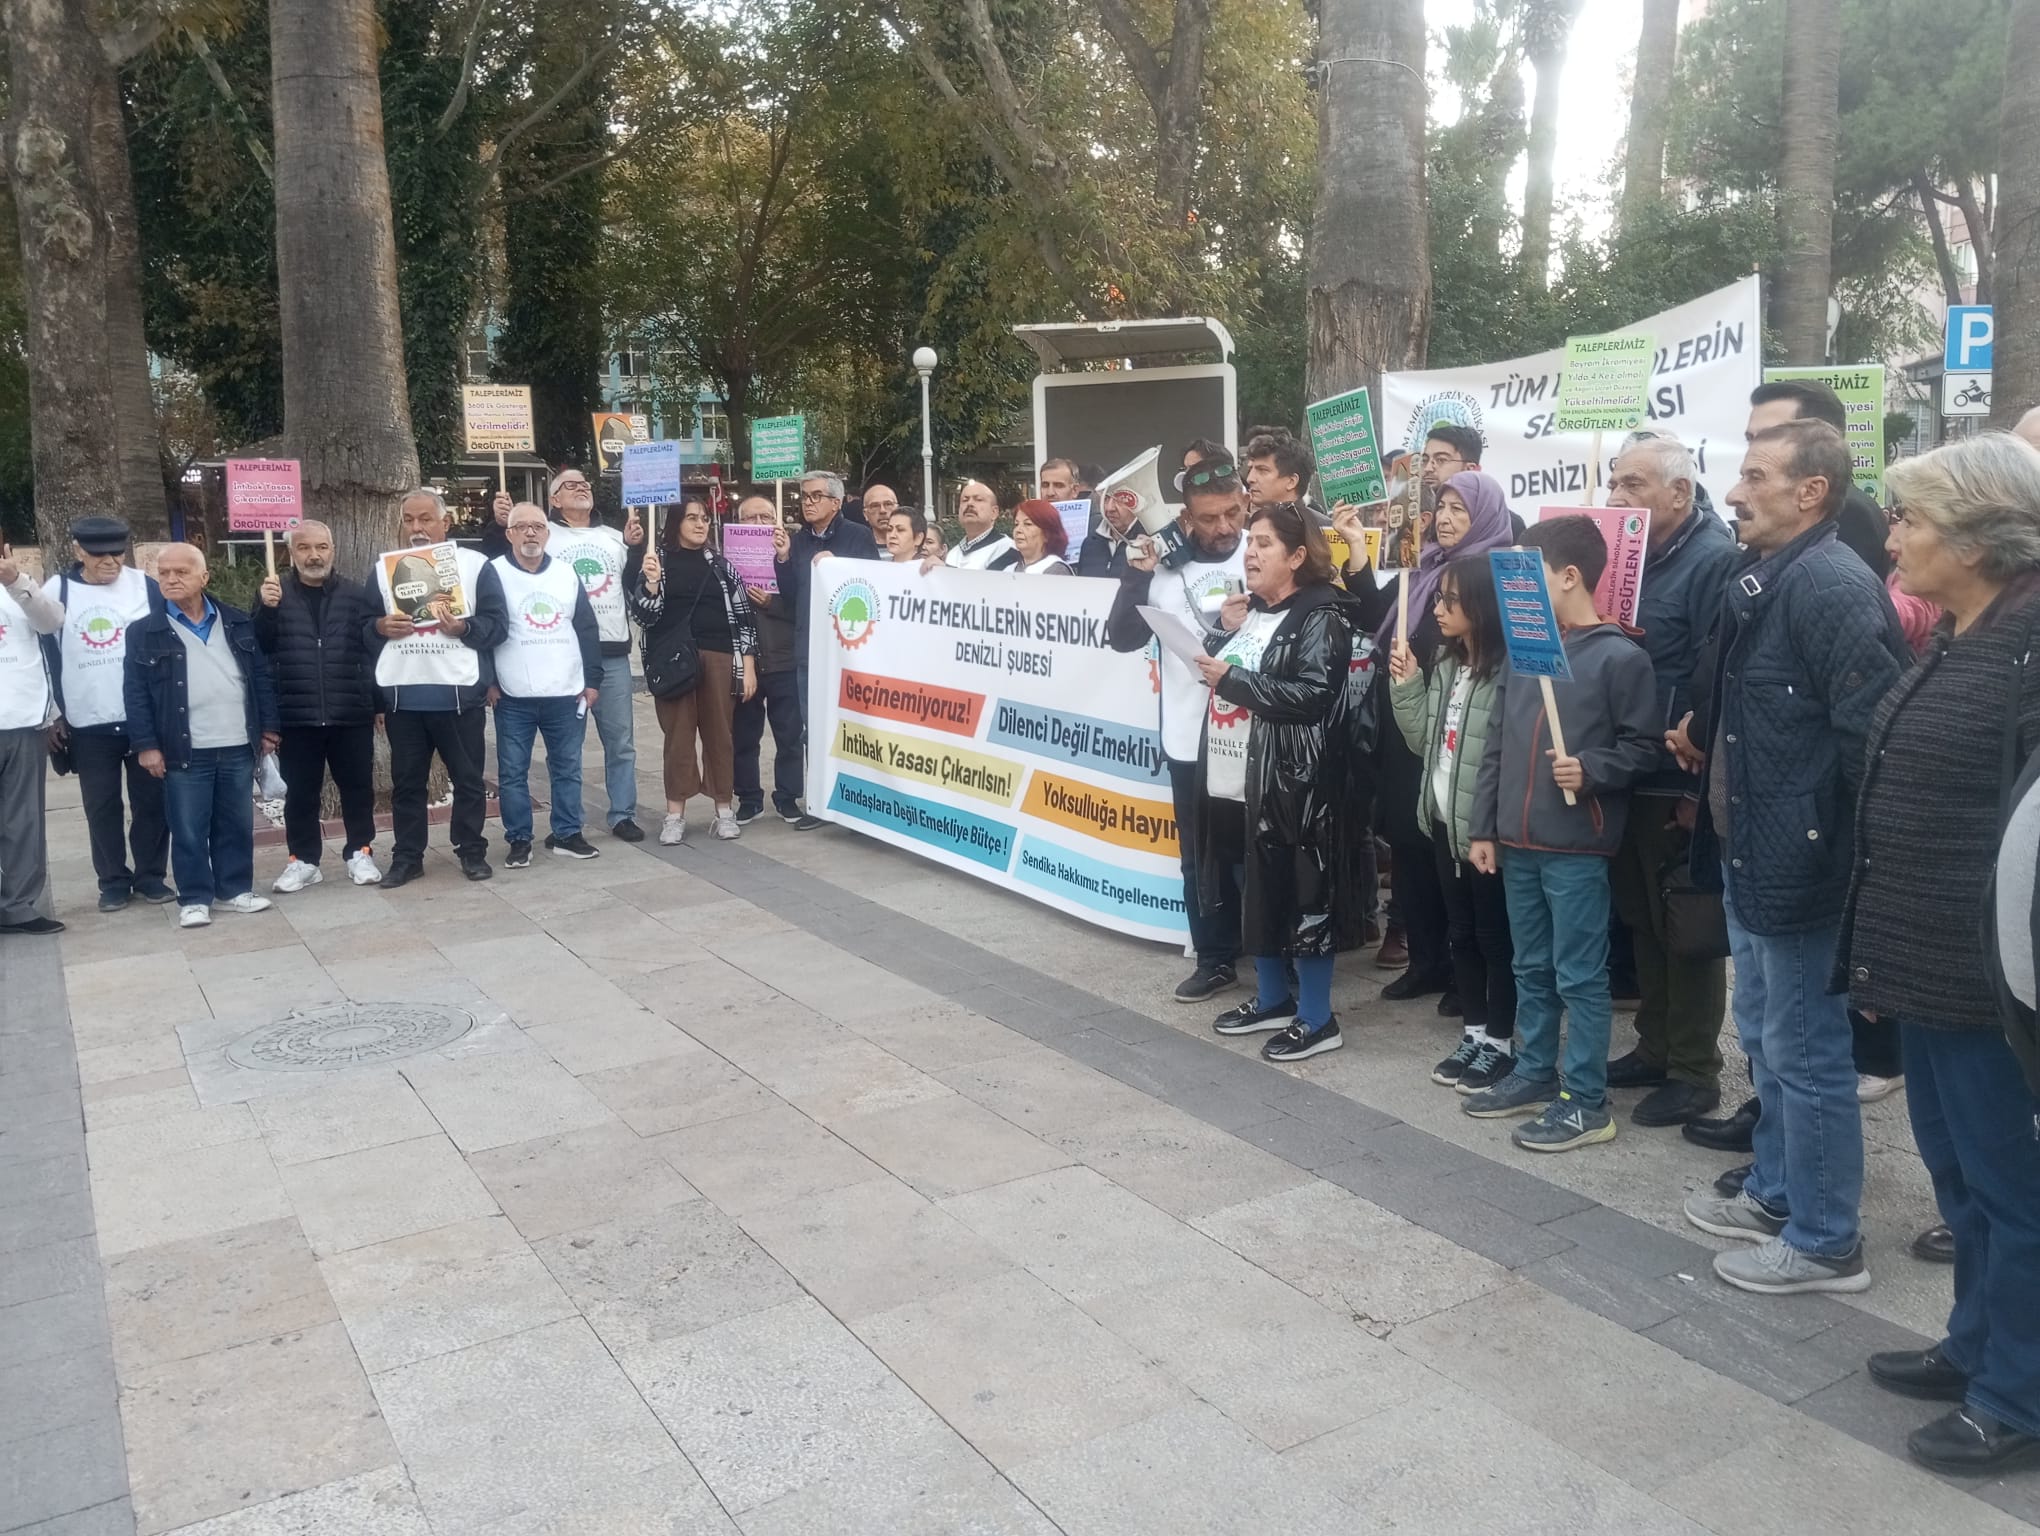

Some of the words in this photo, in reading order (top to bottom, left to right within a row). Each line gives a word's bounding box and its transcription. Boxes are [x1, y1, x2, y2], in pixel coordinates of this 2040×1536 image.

[1575, 338, 1646, 353] TALEPLERİMİZ
[1960, 313, 1994, 365] P
[1569, 360, 1600, 369] Bayram
[1602, 356, 1646, 367] İkramiyesi
[1568, 373, 1589, 381] Yılda
[470, 388, 524, 397] TALEPLERİMİZ
[1490, 373, 1548, 409] TÜM
[1564, 396, 1640, 407] Yükseltilmelidir!
[1312, 397, 1361, 422] TALEPLERİMİZ
[469, 421, 529, 430] Verilmelidir!
[757, 418, 798, 430] TALEPLERİMİZ
[1558, 416, 1616, 430] ÖRGÜTLEN
[1618, 418, 1623, 429] !
[471, 441, 515, 450] ÖRGÜTLEN
[629, 444, 673, 455] TALEPLERİMİZ
[233, 463, 293, 472] TALEPLERİMİZ
[755, 470, 789, 479] ÖRGÜTLEN
[625, 495, 663, 505] ÖRGÜTLEN
[233, 519, 281, 529] ÖRGÜTLEN
[1612, 516, 1626, 569] SENDİKASINDA
[1619, 549, 1640, 623] RGÜTLEN
[888, 589, 926, 624] TÜM
[929, 597, 1031, 639] EMEKLİLERİN
[1035, 608, 1113, 649] SENDİKA
[955, 638, 1002, 669] DENİZLİ
[1007, 649, 1053, 678] ŞUBESİ
[846, 675, 972, 725] Geçinemiyoruz!
[998, 706, 1048, 743] Dilenci
[1051, 718, 1091, 757] Değil
[1092, 727, 1164, 776] Emekliy
[842, 723, 884, 763] İntibak
[888, 742, 938, 777] Yasası
[941, 755, 1012, 798] Çıkarılsın!
[1043, 780, 1118, 831] Yoksulluğa
[839, 782, 892, 818] Yandaşlara
[893, 801, 918, 826] Değil
[919, 810, 969, 844] Emekliye
[970, 824, 1001, 855] Bütçe
[1003, 836, 1008, 856] !
[1022, 850, 1057, 876] Sendika
[1057, 862, 1100, 893] Hakkımız
[1101, 879, 1186, 914] Engellenem
